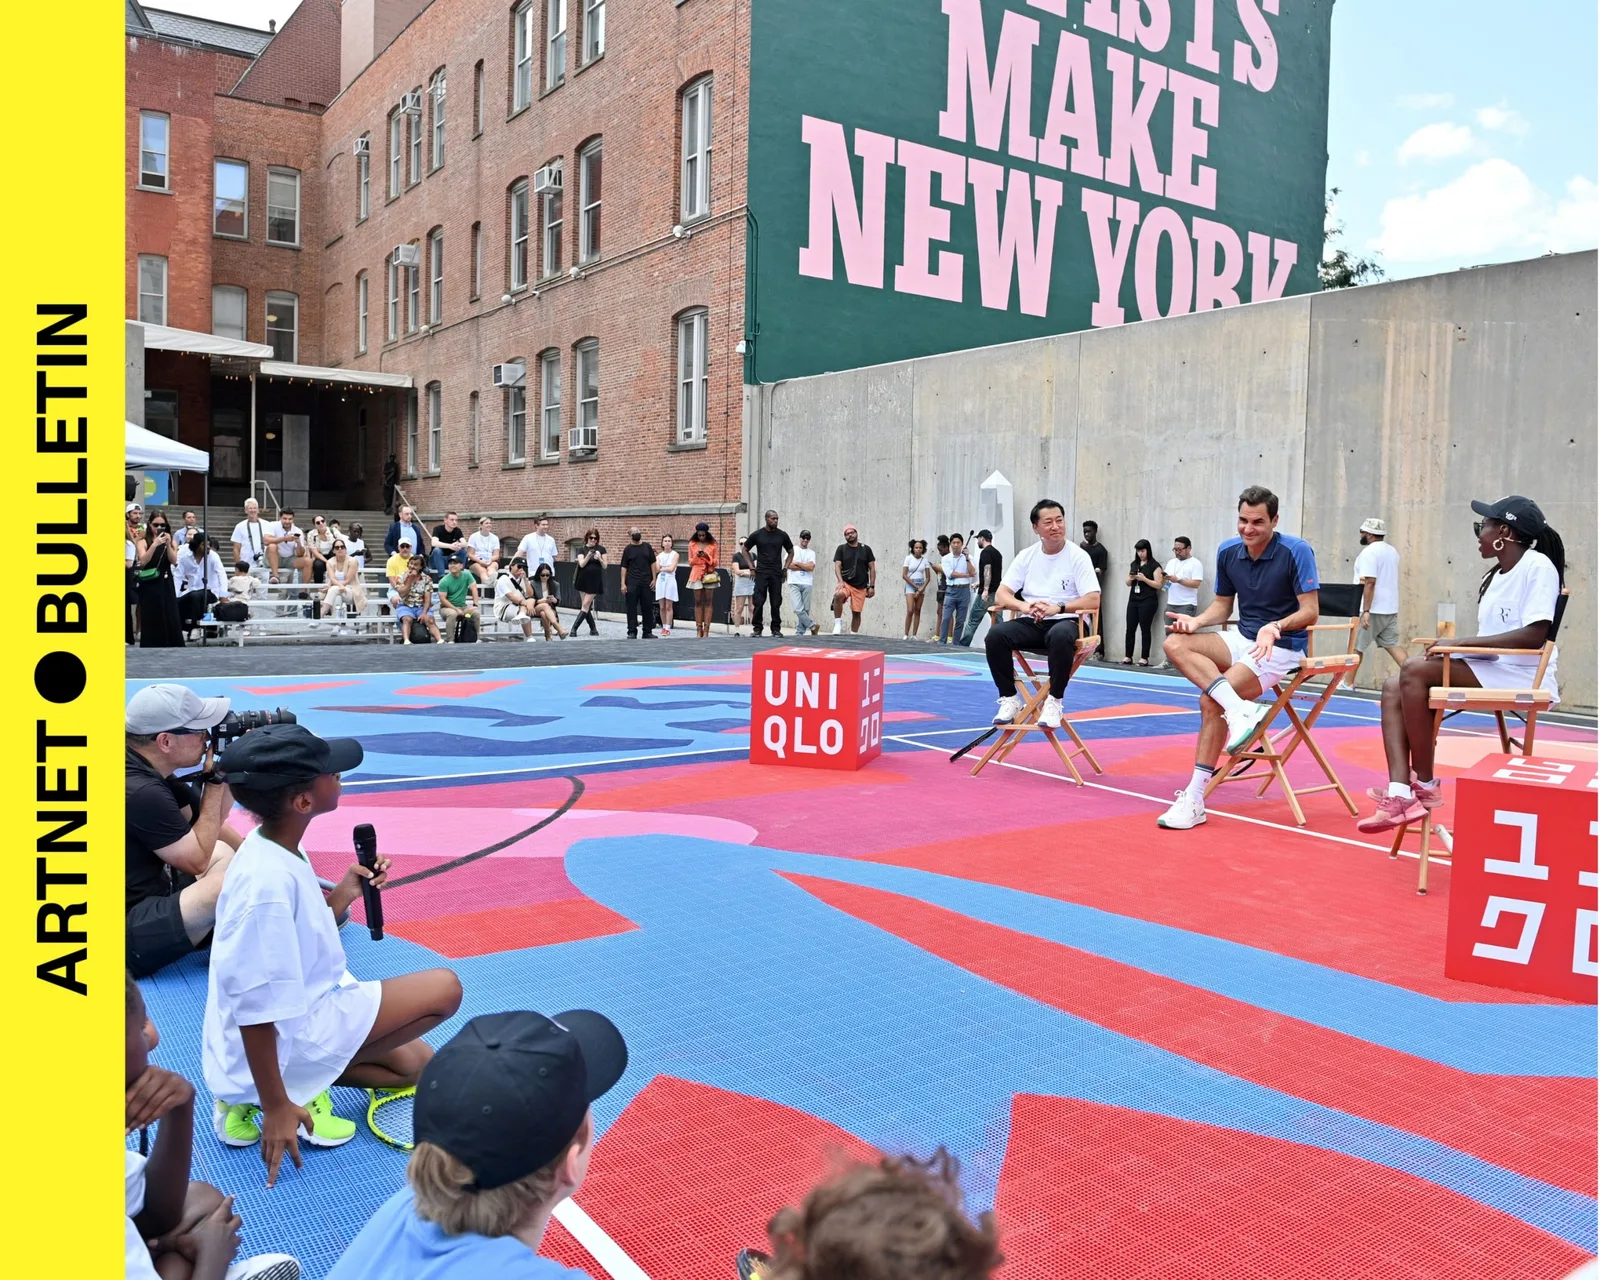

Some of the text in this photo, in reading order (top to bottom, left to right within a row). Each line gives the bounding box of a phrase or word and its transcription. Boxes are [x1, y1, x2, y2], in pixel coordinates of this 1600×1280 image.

[939, 0, 1219, 210] MAKE
[799, 114, 1063, 318] NEW
[763, 715, 844, 759] QLO
[764, 669, 838, 710] UNI
